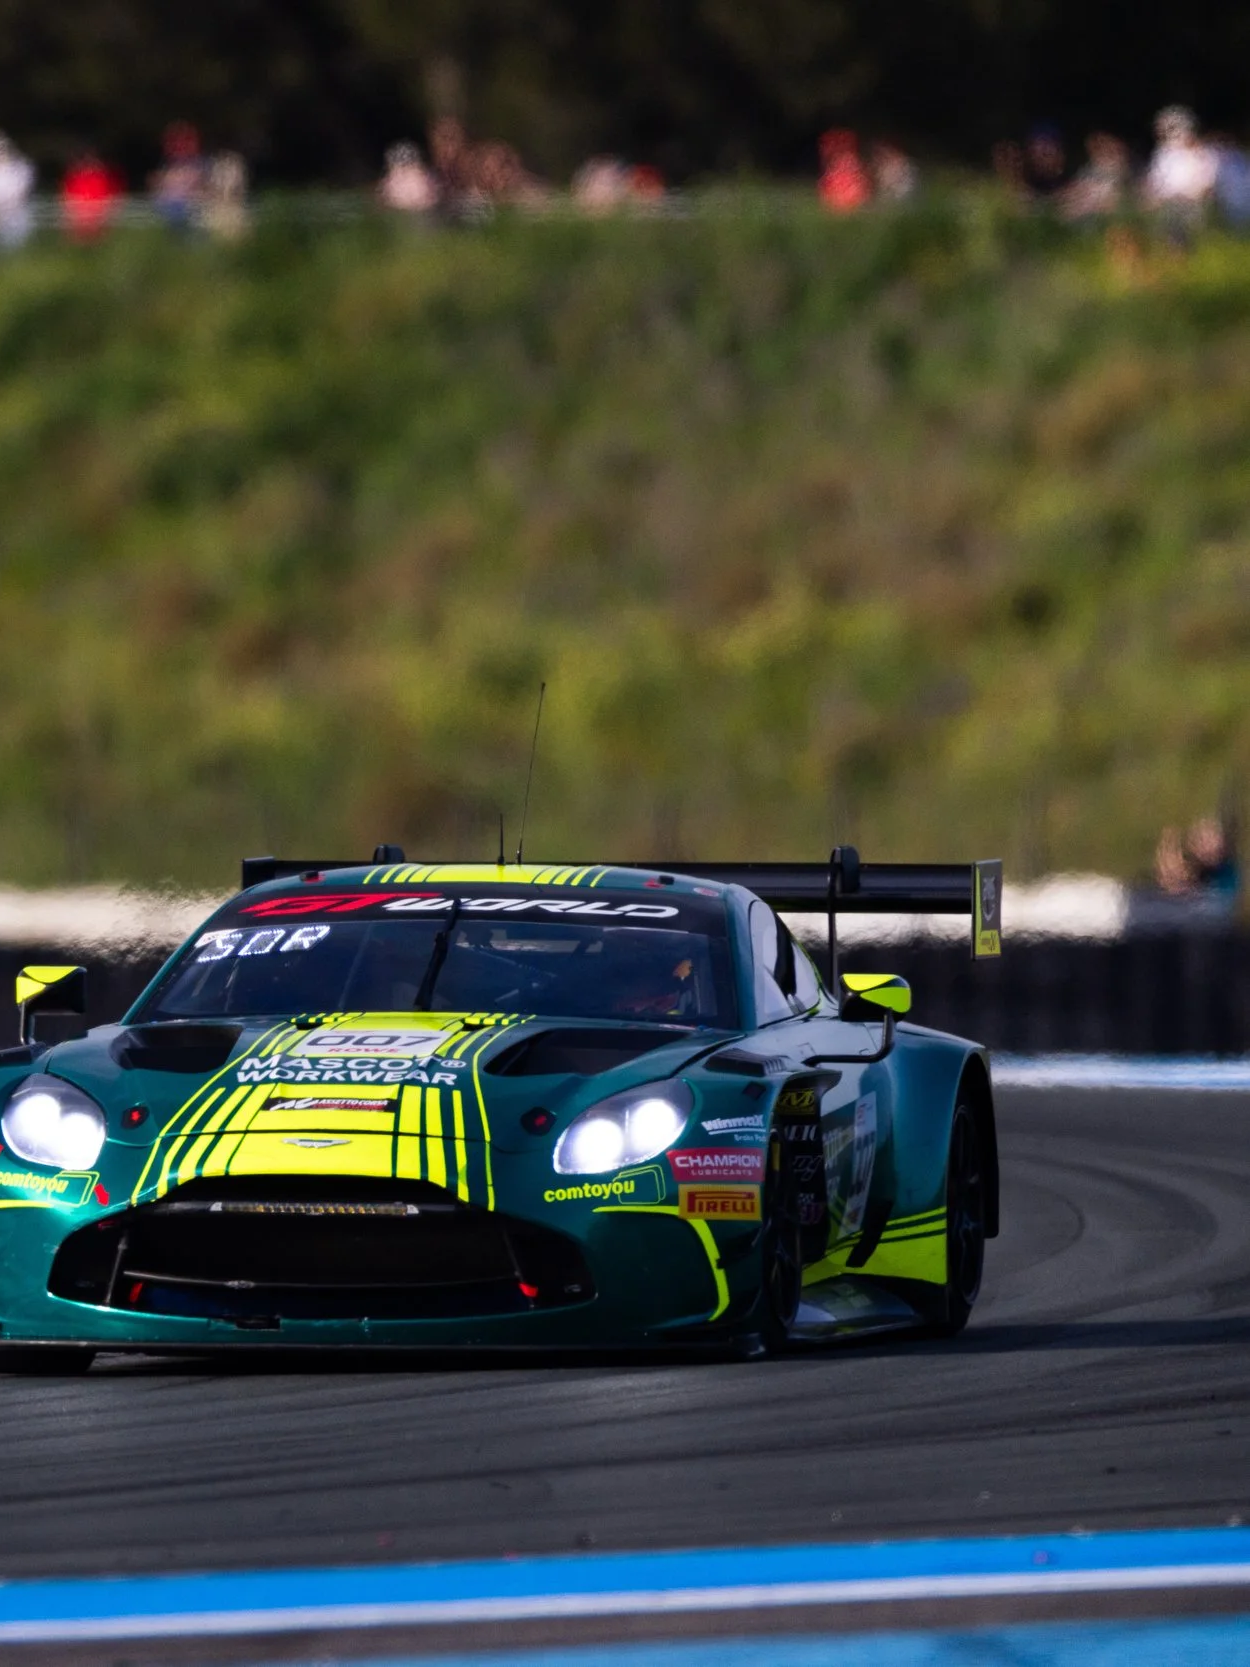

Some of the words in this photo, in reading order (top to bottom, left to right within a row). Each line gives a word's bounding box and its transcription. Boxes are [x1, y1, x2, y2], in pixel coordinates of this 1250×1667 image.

[196, 925, 330, 962] SOR
[306, 1035, 440, 1047] 007
[236, 1068, 458, 1085] WORKWEAR
[674, 1153, 762, 1168] CHAMPION
[690, 1168, 754, 1176] LUBRICANTS
[543, 1179, 635, 1203] comtoyou
[686, 1190, 756, 1214] PIRELLI
